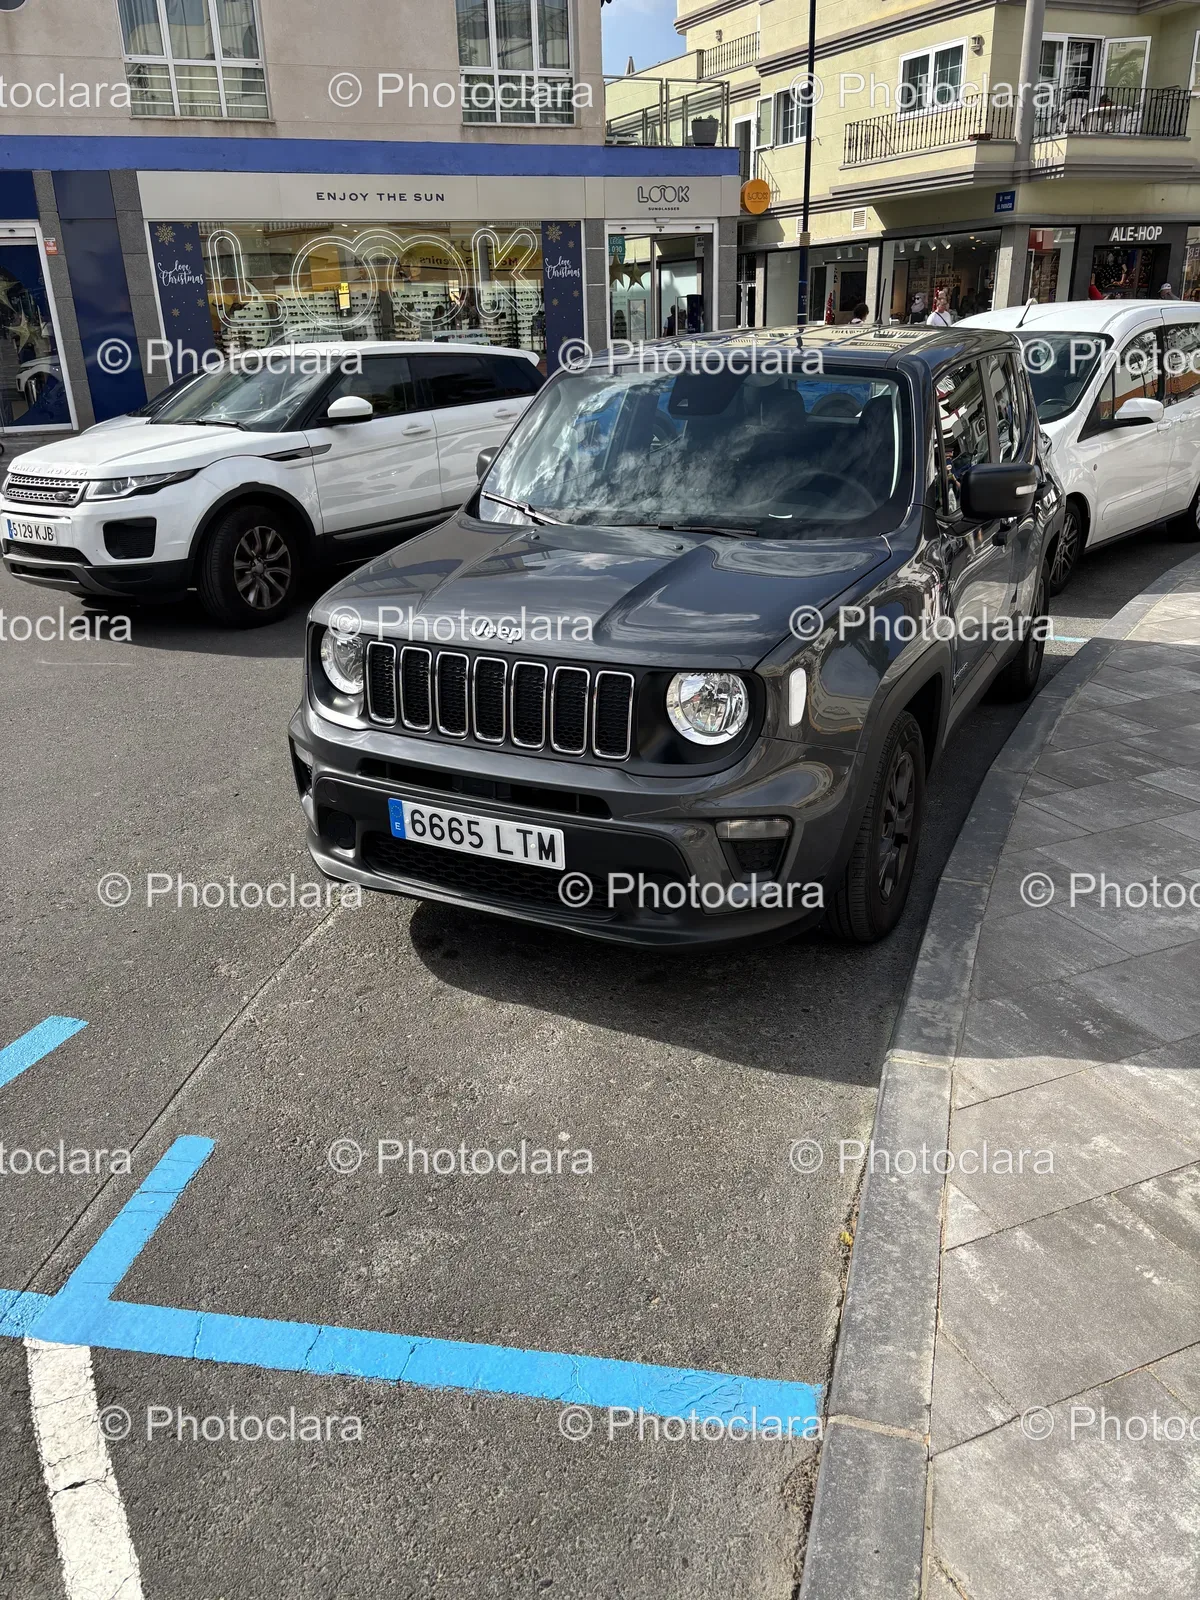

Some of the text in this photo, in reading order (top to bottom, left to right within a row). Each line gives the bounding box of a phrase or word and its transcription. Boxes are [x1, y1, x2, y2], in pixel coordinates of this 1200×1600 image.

[316, 192, 445, 202] ENJOY THE SUN
[637, 184, 690, 203] LOOK
[747, 191, 768, 200] LOOK
[1109, 225, 1163, 242] ALE-HOP
[159, 269, 204, 287] Christmas
[208, 228, 542, 331] LOOK
[546, 264, 580, 279] Christmas
[12, 522, 34, 538] 5129
[34, 525, 55, 541] KJB
[470, 620, 522, 645] Jeep
[410, 809, 484, 849] 6665
[495, 824, 556, 863] LTM
